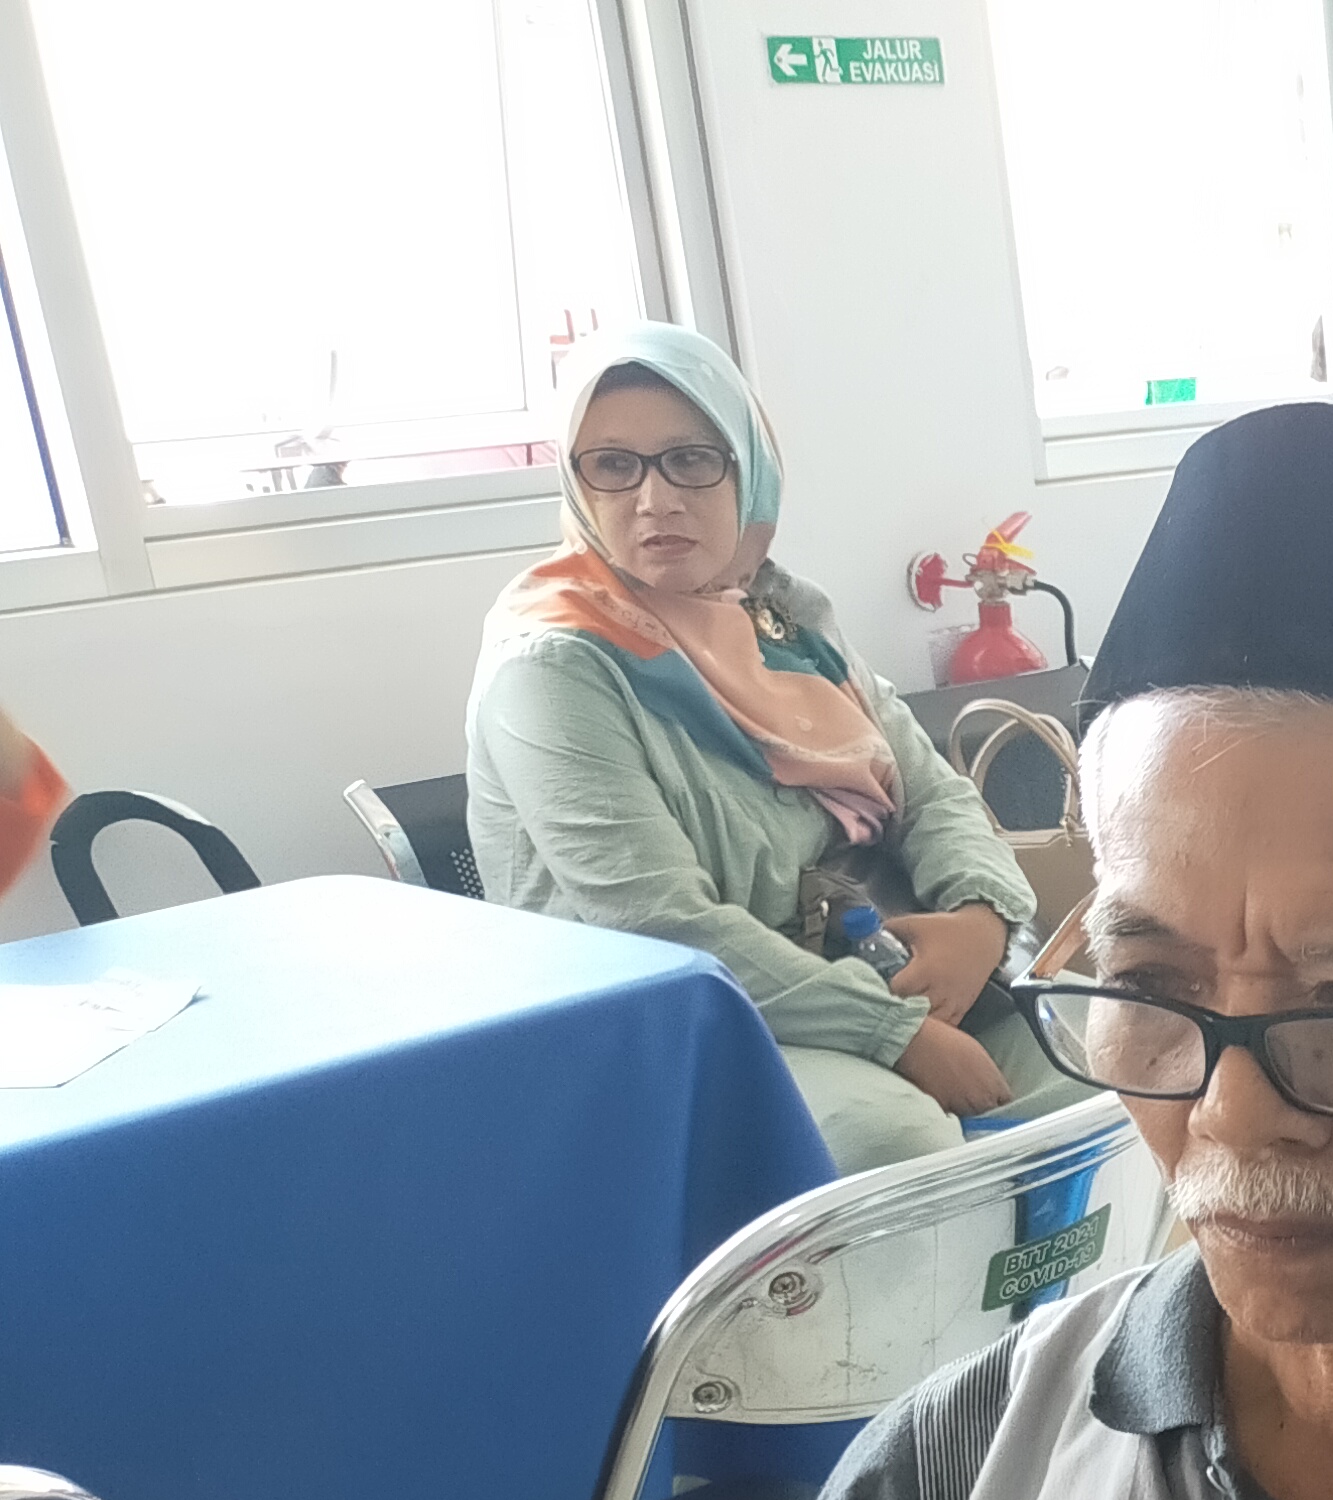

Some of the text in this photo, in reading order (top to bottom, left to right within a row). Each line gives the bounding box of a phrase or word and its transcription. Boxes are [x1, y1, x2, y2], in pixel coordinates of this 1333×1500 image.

[862, 39, 922, 60] JALUR
[849, 61, 940, 83] EVAKUASI
[1003, 1215, 1100, 1276] BTT 2021
[1001, 1241, 1097, 1300] COVID-19
